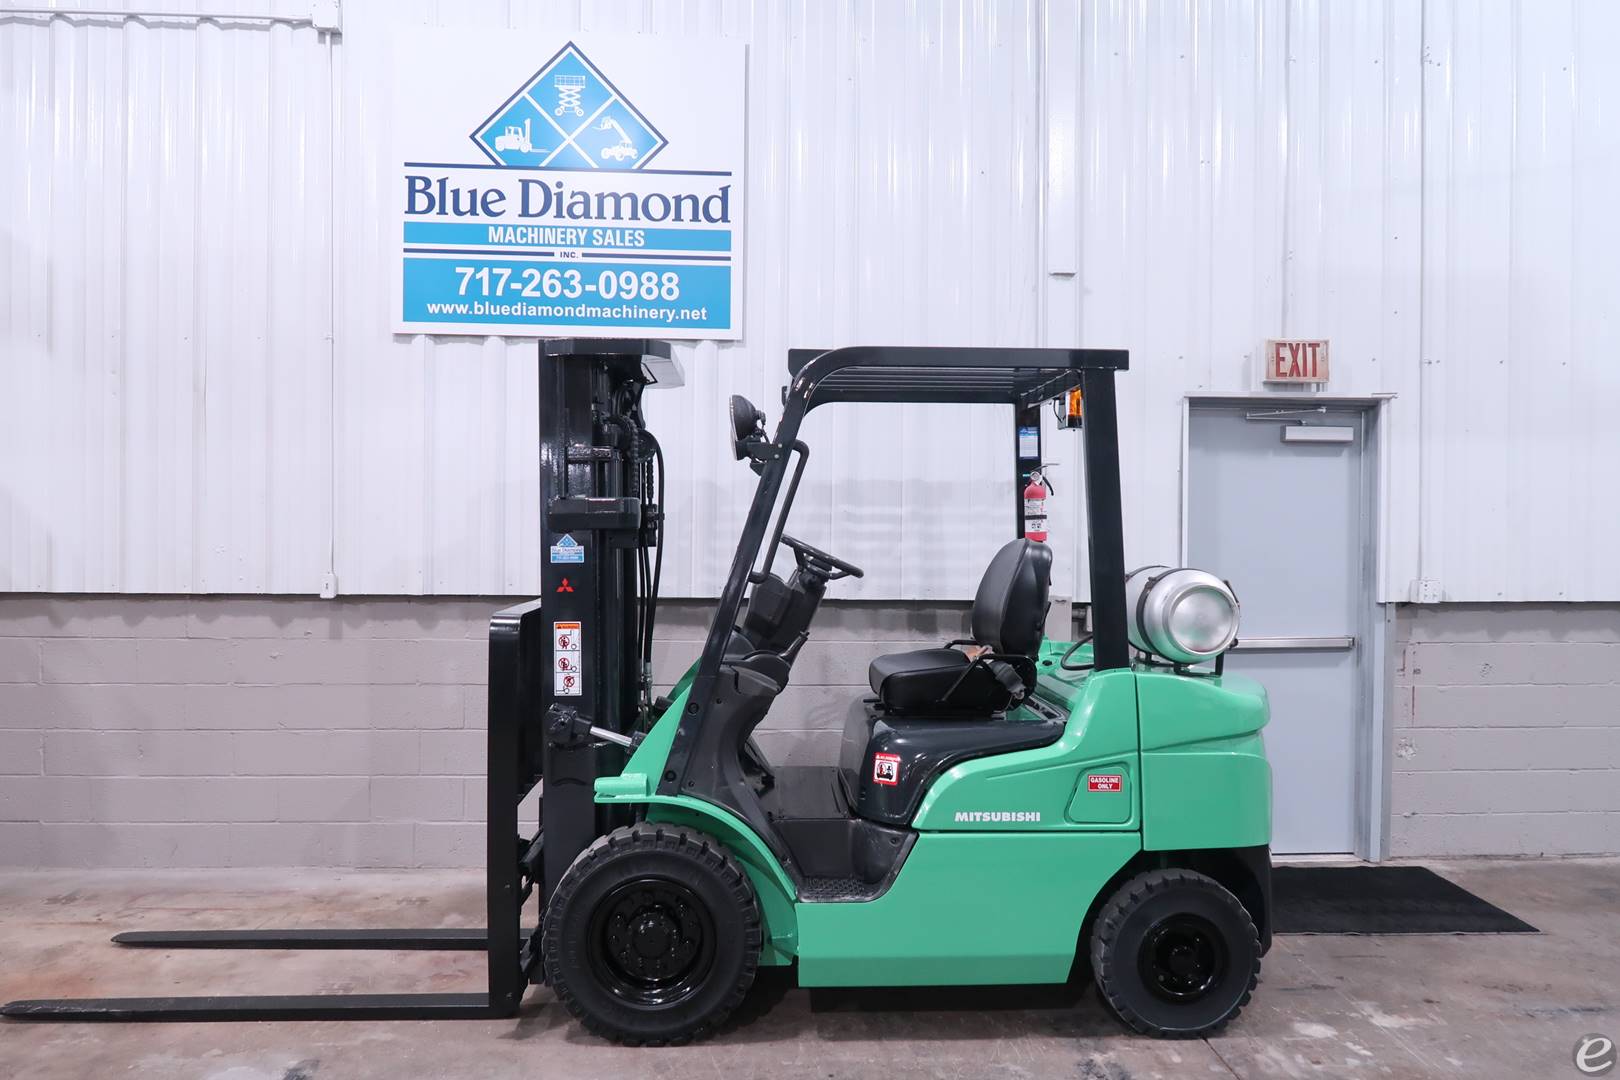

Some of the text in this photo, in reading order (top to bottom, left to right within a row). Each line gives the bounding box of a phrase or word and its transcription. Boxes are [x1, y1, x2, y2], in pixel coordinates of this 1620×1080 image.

[404, 175, 732, 223] Blue Diamond
[488, 225, 645, 247] MACHINERY SALES
[559, 251, 579, 259] INC.
[455, 266, 680, 301] 717-263-0988
[427, 301, 707, 323] www.bluediamondmachinery.net
[1274, 342, 1321, 378] EXIT
[955, 811, 1041, 822] MITSUBISHI
